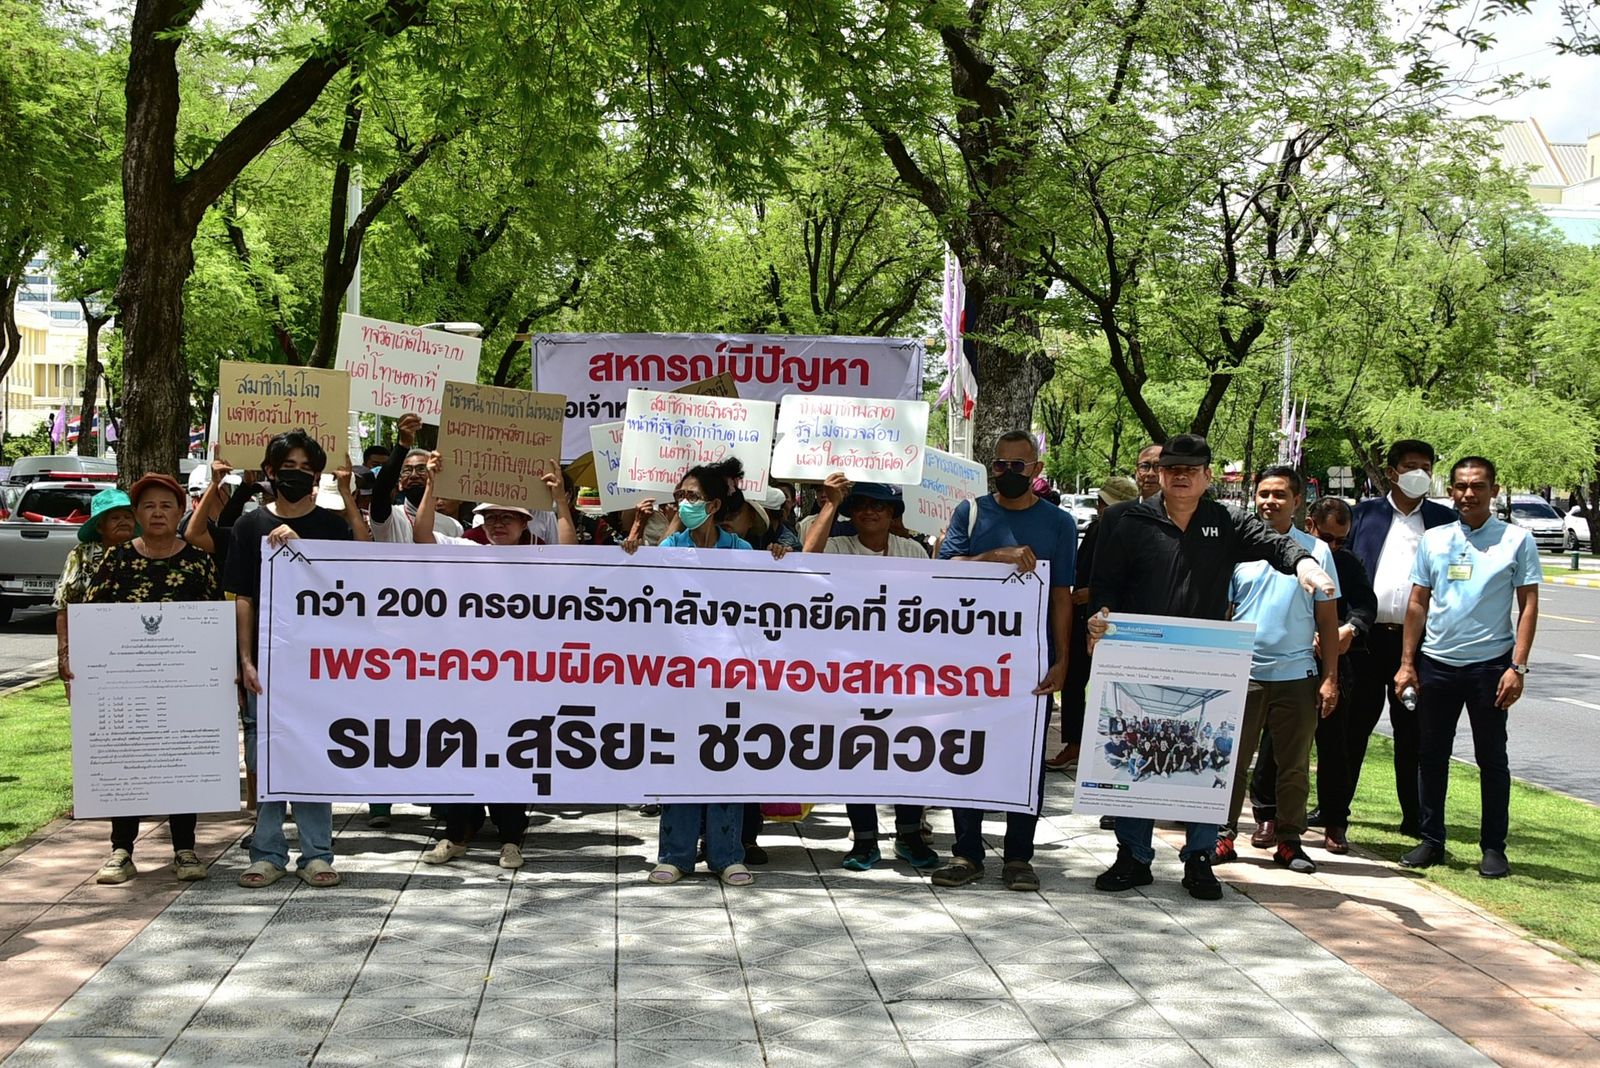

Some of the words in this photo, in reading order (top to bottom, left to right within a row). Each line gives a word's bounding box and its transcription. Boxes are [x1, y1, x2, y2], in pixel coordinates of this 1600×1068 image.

[235, 370, 320, 398] สมาชิกไม่โกง
[588, 343, 870, 392] สหกรณ์มีปัญหา
[458, 469, 528, 500] ที่ล้มเหลว
[1201, 526, 1219, 537] VH
[295, 580, 366, 617] กว่า
[377, 588, 448, 617] 200
[458, 584, 887, 641] ครอบครัวกำลังจะถูกยึดที่
[897, 595, 1023, 637] ยึดบ้าน
[309, 642, 1012, 698] เพราะความผิดพลาดของสหกรณ์
[327, 705, 675, 796] รมต.สุริยะ
[698, 702, 986, 775] ช่วยด้วย
